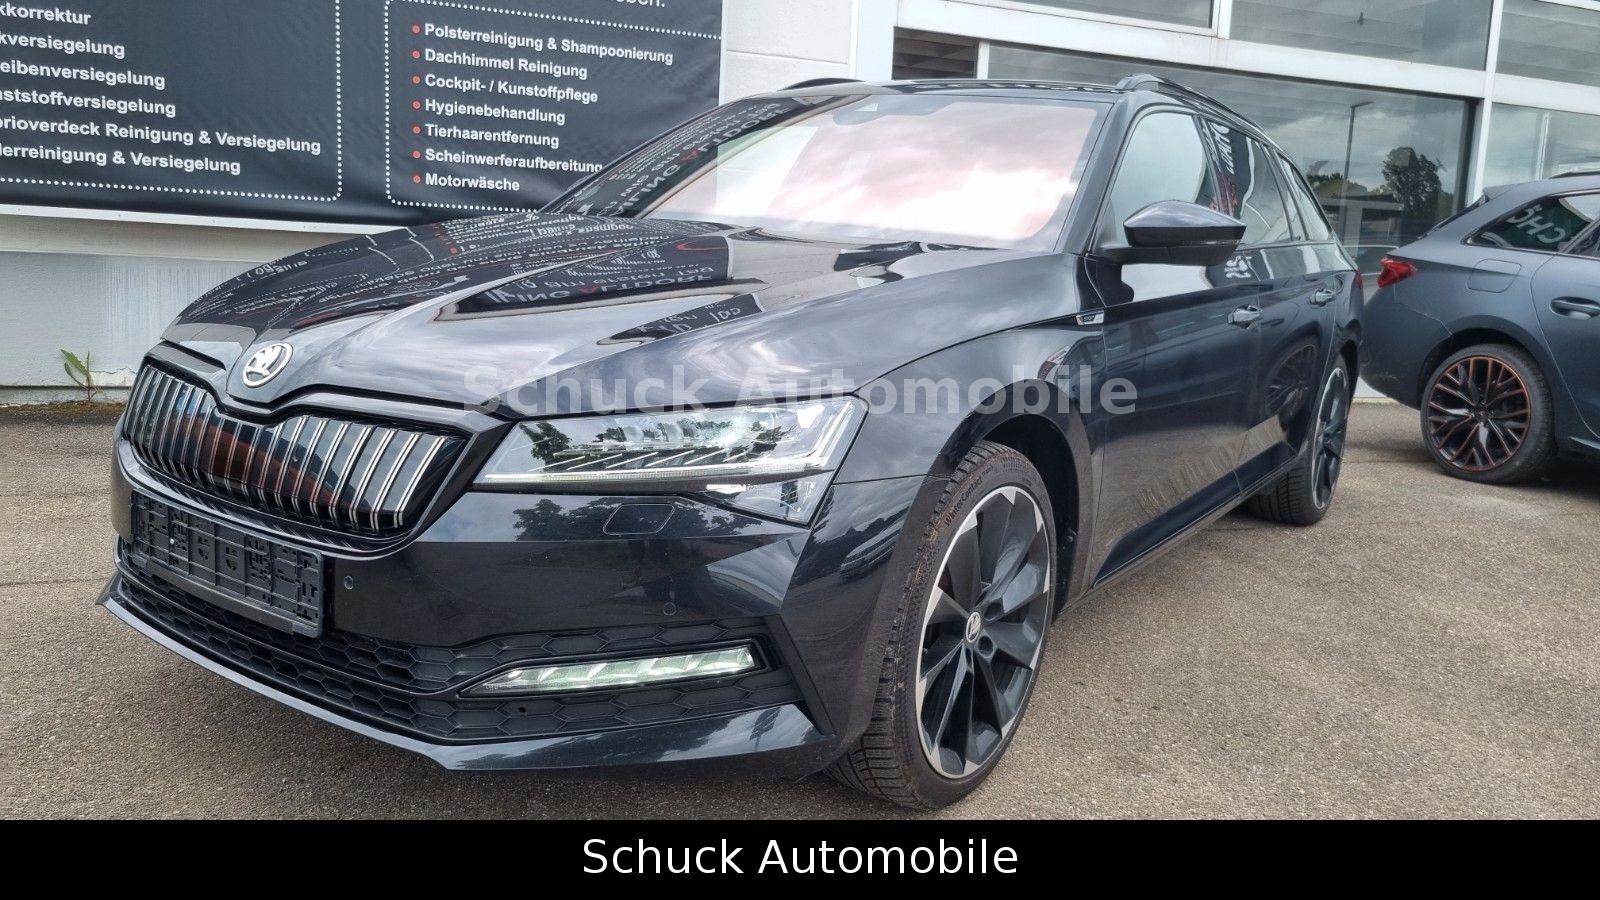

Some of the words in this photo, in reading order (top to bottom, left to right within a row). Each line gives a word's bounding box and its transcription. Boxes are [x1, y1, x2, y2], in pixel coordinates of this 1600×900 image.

[425, 23, 543, 50] Polsterreinigung
[547, 36, 558, 50] &
[561, 39, 674, 66] Shampoonierung
[425, 49, 514, 71] Dachhimmel
[518, 59, 588, 81] Reinigung
[425, 74, 486, 92] Cockpit-
[488, 80, 496, 94] /
[498, 80, 599, 105] Kunstoffpflege
[425, 99, 566, 126] Hygienebehandlung
[105, 123, 194, 146] Reinigung
[199, 131, 211, 145] &
[216, 132, 321, 155] Versiegelung
[425, 124, 560, 150] Tierhaarentfernung
[112, 150, 126, 166] &
[130, 152, 241, 176] Versiegelung
[425, 173, 520, 192] Motorwäsche
